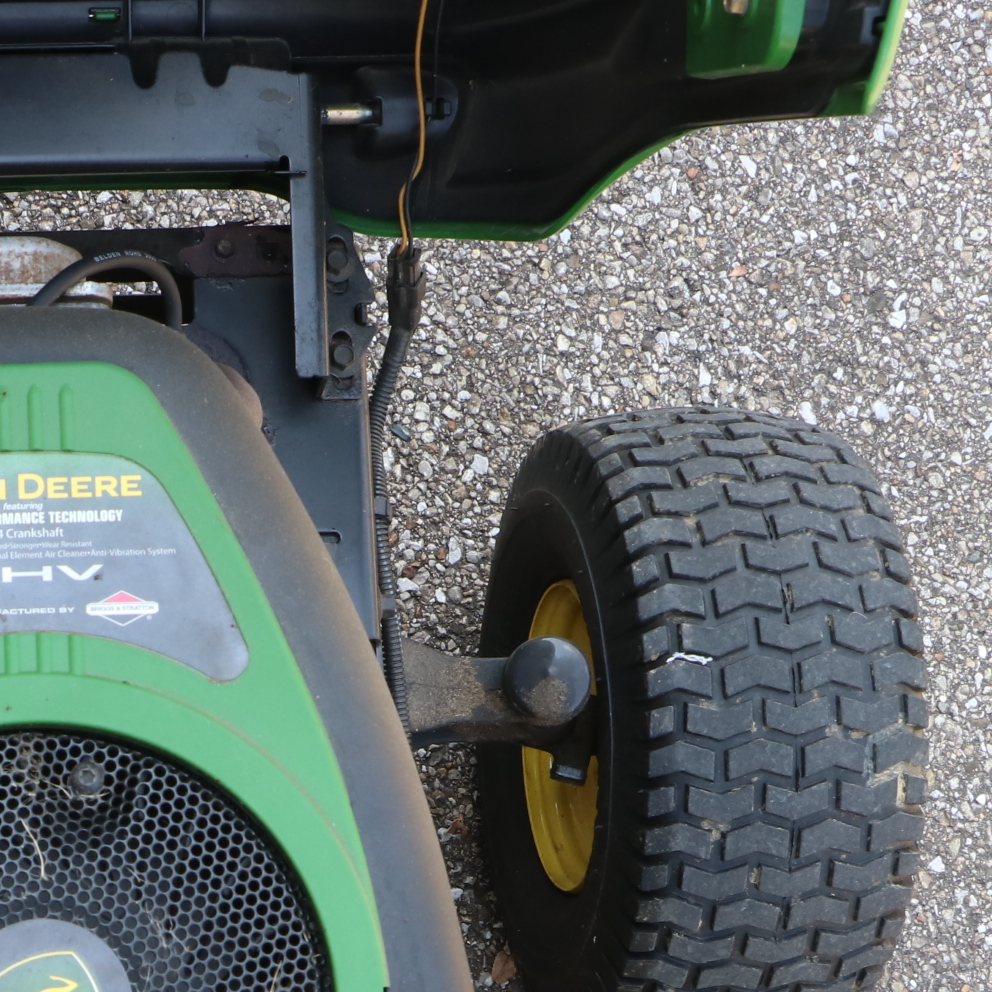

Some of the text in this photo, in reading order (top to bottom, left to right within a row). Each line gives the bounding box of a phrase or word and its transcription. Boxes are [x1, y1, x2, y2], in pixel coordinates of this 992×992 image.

[94, 250, 121, 262] BELDEN
[18, 472, 142, 500] DEERE
[3, 502, 43, 512] featuring
[48, 510, 123, 524] TECHNOLOGY
[6, 527, 64, 538] Crankshaft
[61, 540, 92, 548] Resistant
[10, 551, 42, 559] Element
[44, 550, 56, 558] Air
[147, 547, 176, 556] System
